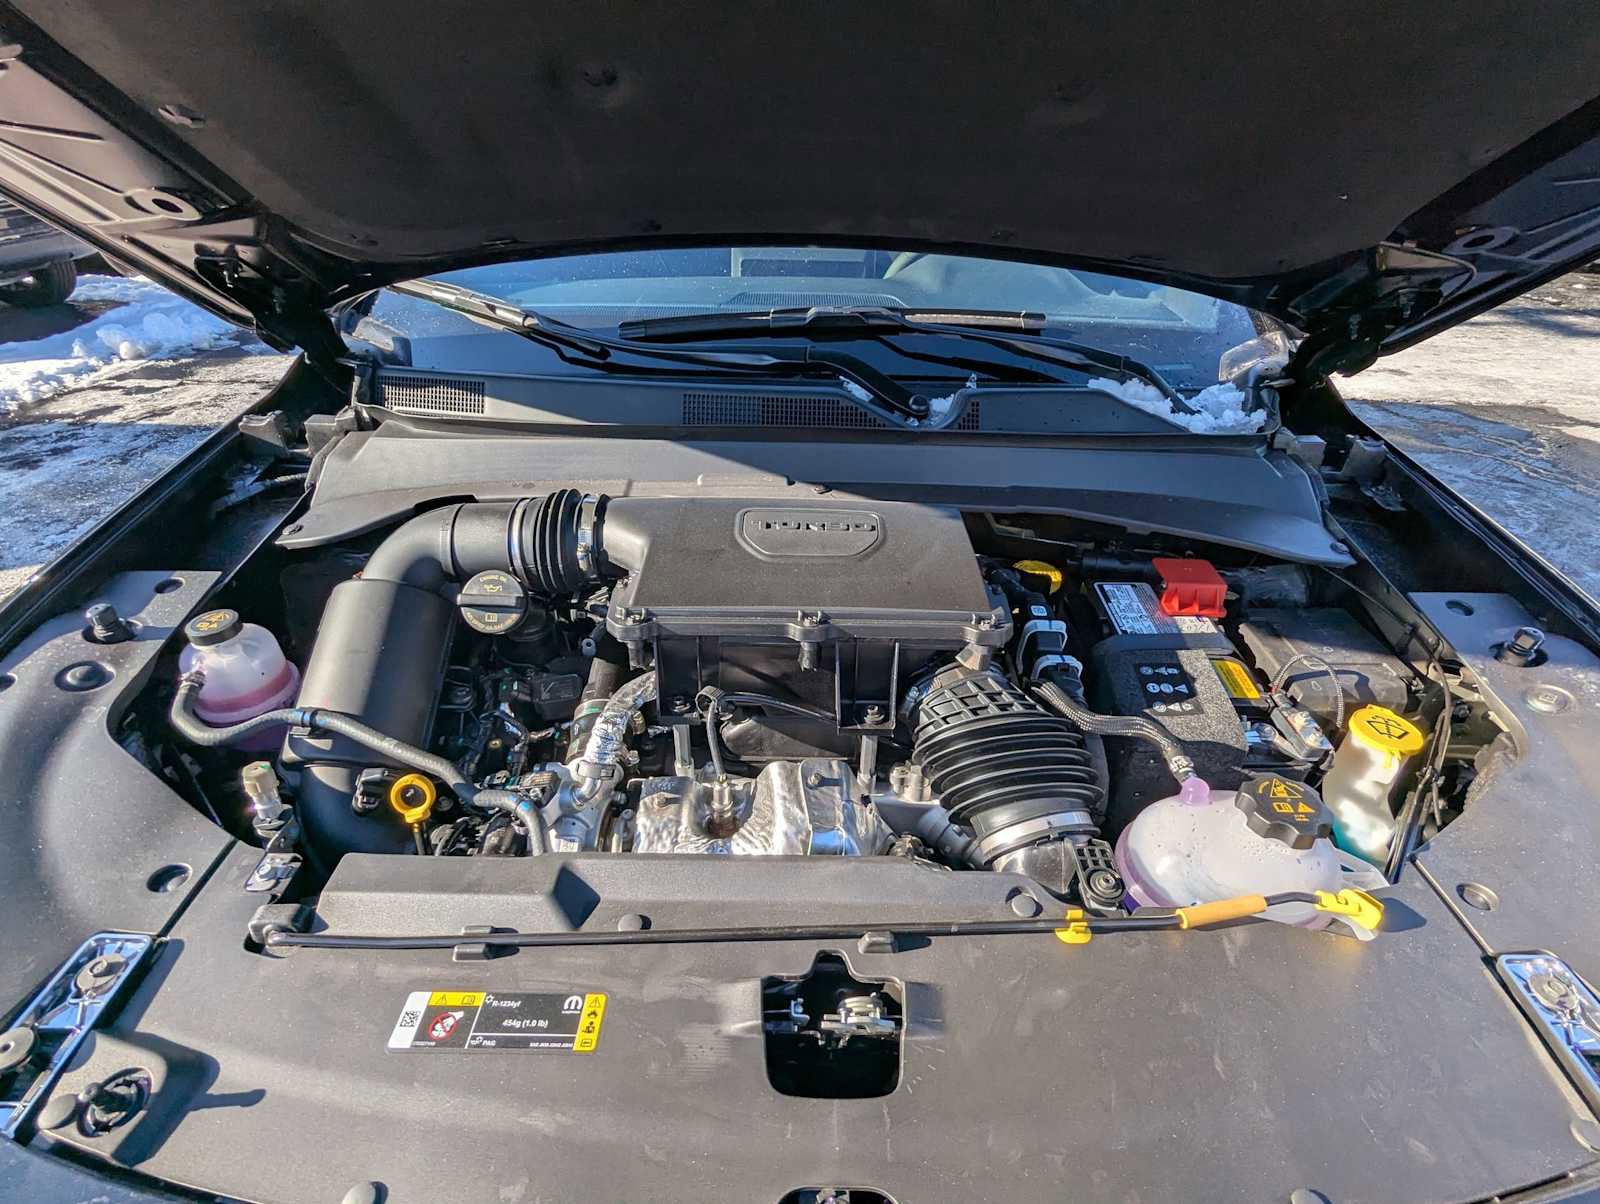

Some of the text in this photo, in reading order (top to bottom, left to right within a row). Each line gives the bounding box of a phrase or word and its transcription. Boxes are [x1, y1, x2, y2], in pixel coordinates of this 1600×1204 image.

[491, 1000, 522, 1009] R-1234yf
[502, 1019, 549, 1029] 454g (1.0 lb)
